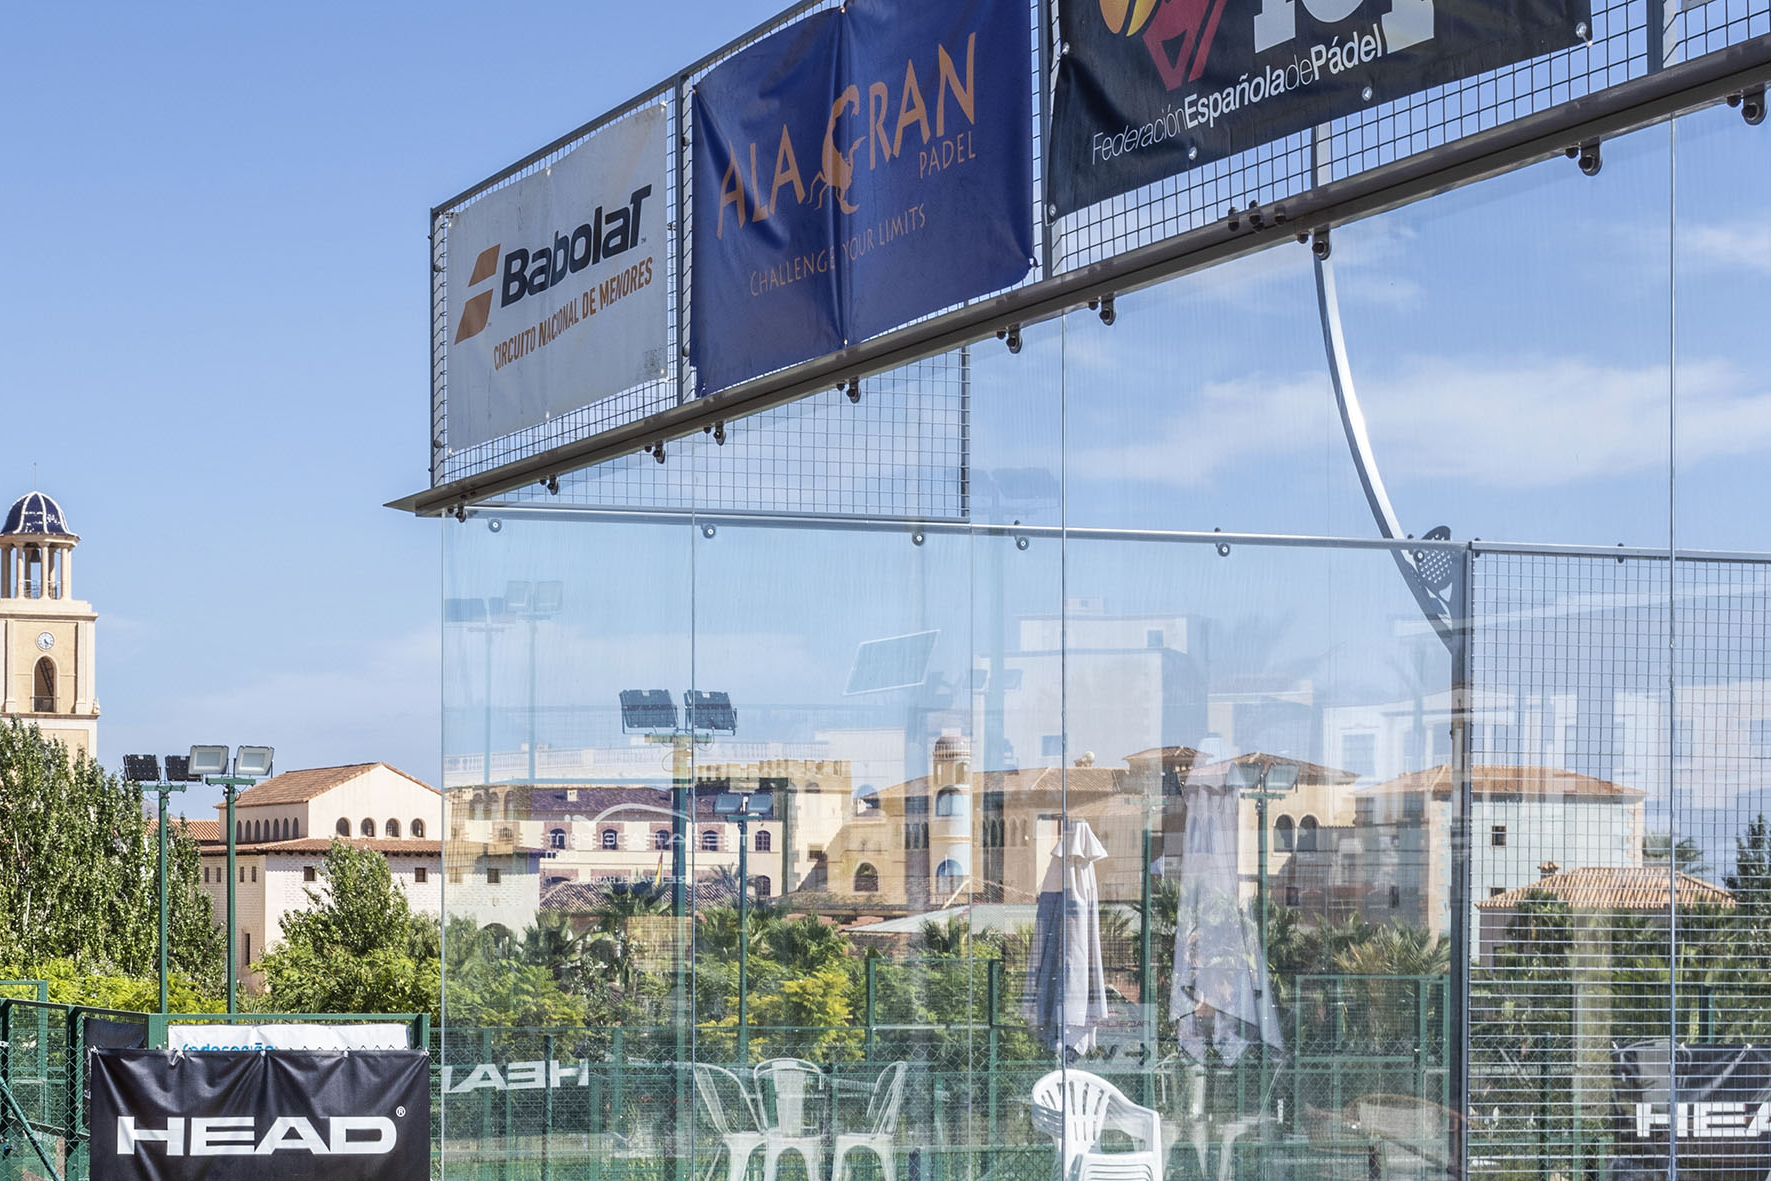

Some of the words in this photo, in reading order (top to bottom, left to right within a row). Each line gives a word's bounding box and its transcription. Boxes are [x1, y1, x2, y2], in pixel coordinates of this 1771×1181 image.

[919, 130, 976, 179] PADEL
[749, 247, 836, 297] CHALLENGE
[841, 228, 875, 261] YOUR
[878, 202, 927, 246] LIMITS
[493, 326, 536, 371] CIRCUITO
[538, 298, 579, 348] NACIONAL
[582, 287, 597, 320] DE
[599, 256, 653, 311] MENORES
[116, 1115, 398, 1156] HEAD
